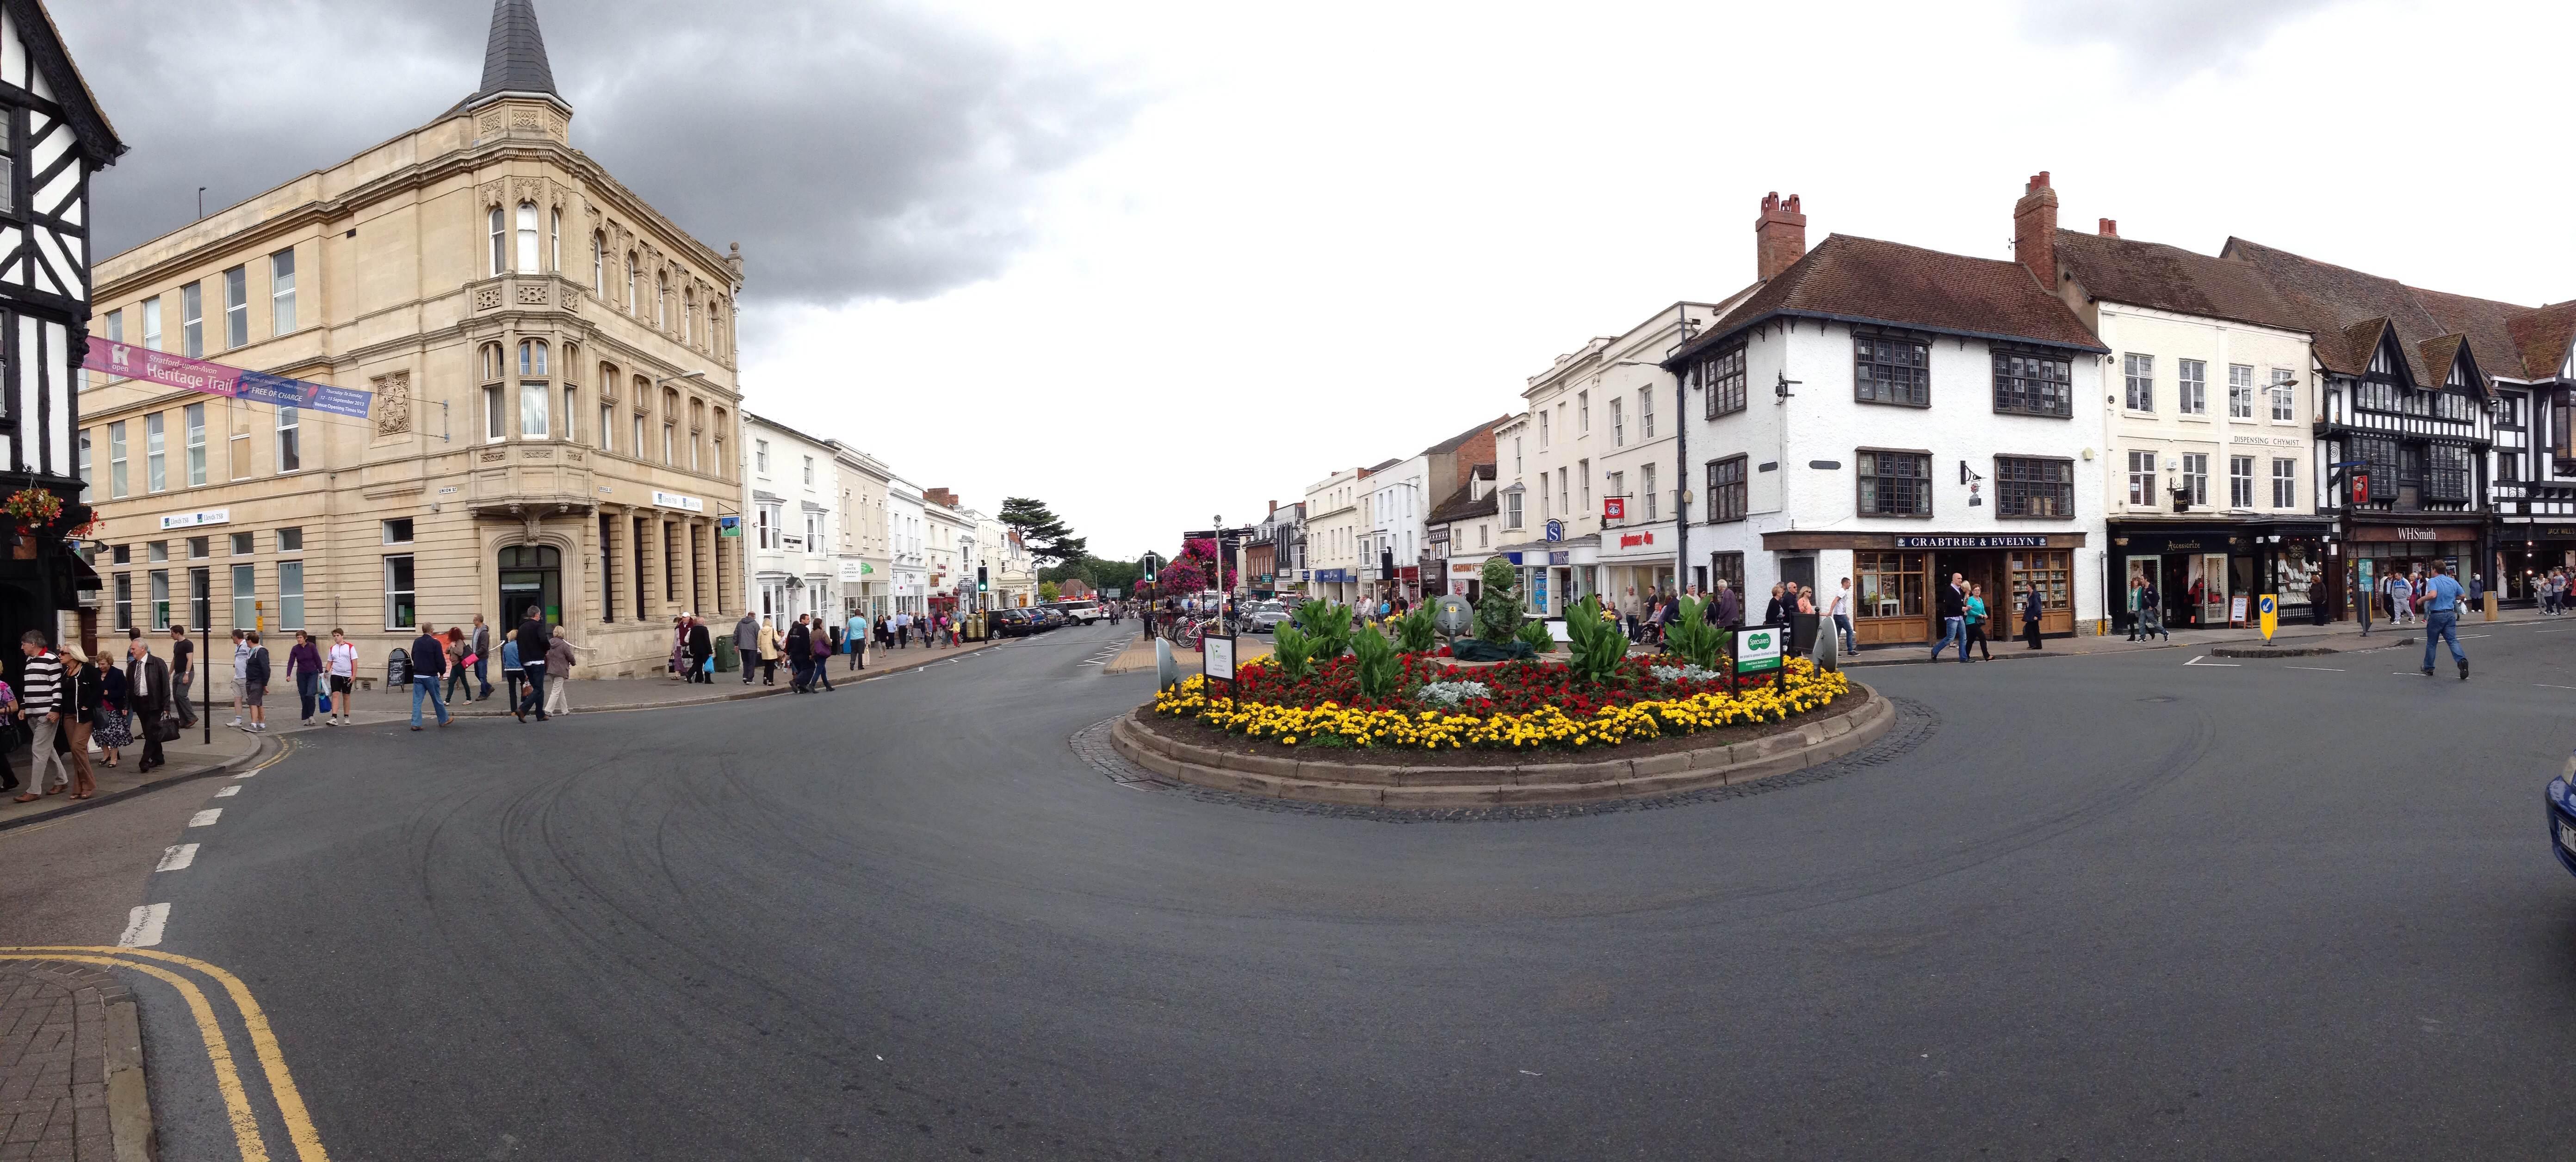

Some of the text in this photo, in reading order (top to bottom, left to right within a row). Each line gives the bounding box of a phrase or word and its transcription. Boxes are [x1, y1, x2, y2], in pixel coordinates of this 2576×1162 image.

[112, 364, 129, 372] open
[148, 354, 217, 375] Stratford-upon-Avon
[147, 363, 234, 392] Heritage Trail
[252, 387, 267, 396] FREE
[278, 392, 302, 402] CHARGE
[328, 403, 345, 412] Opening
[333, 397, 354, 406] September
[2234, 436, 2269, 444] DISPENSING
[1549, 527, 1558, 541] S
[2397, 527, 2436, 540] WHSmith
[1621, 531, 1653, 550] phones 4u
[1911, 538, 1975, 546] CRABTREE
[1992, 537, 2034, 546] EVELYN
[2167, 540, 2200, 551] Accessorize
